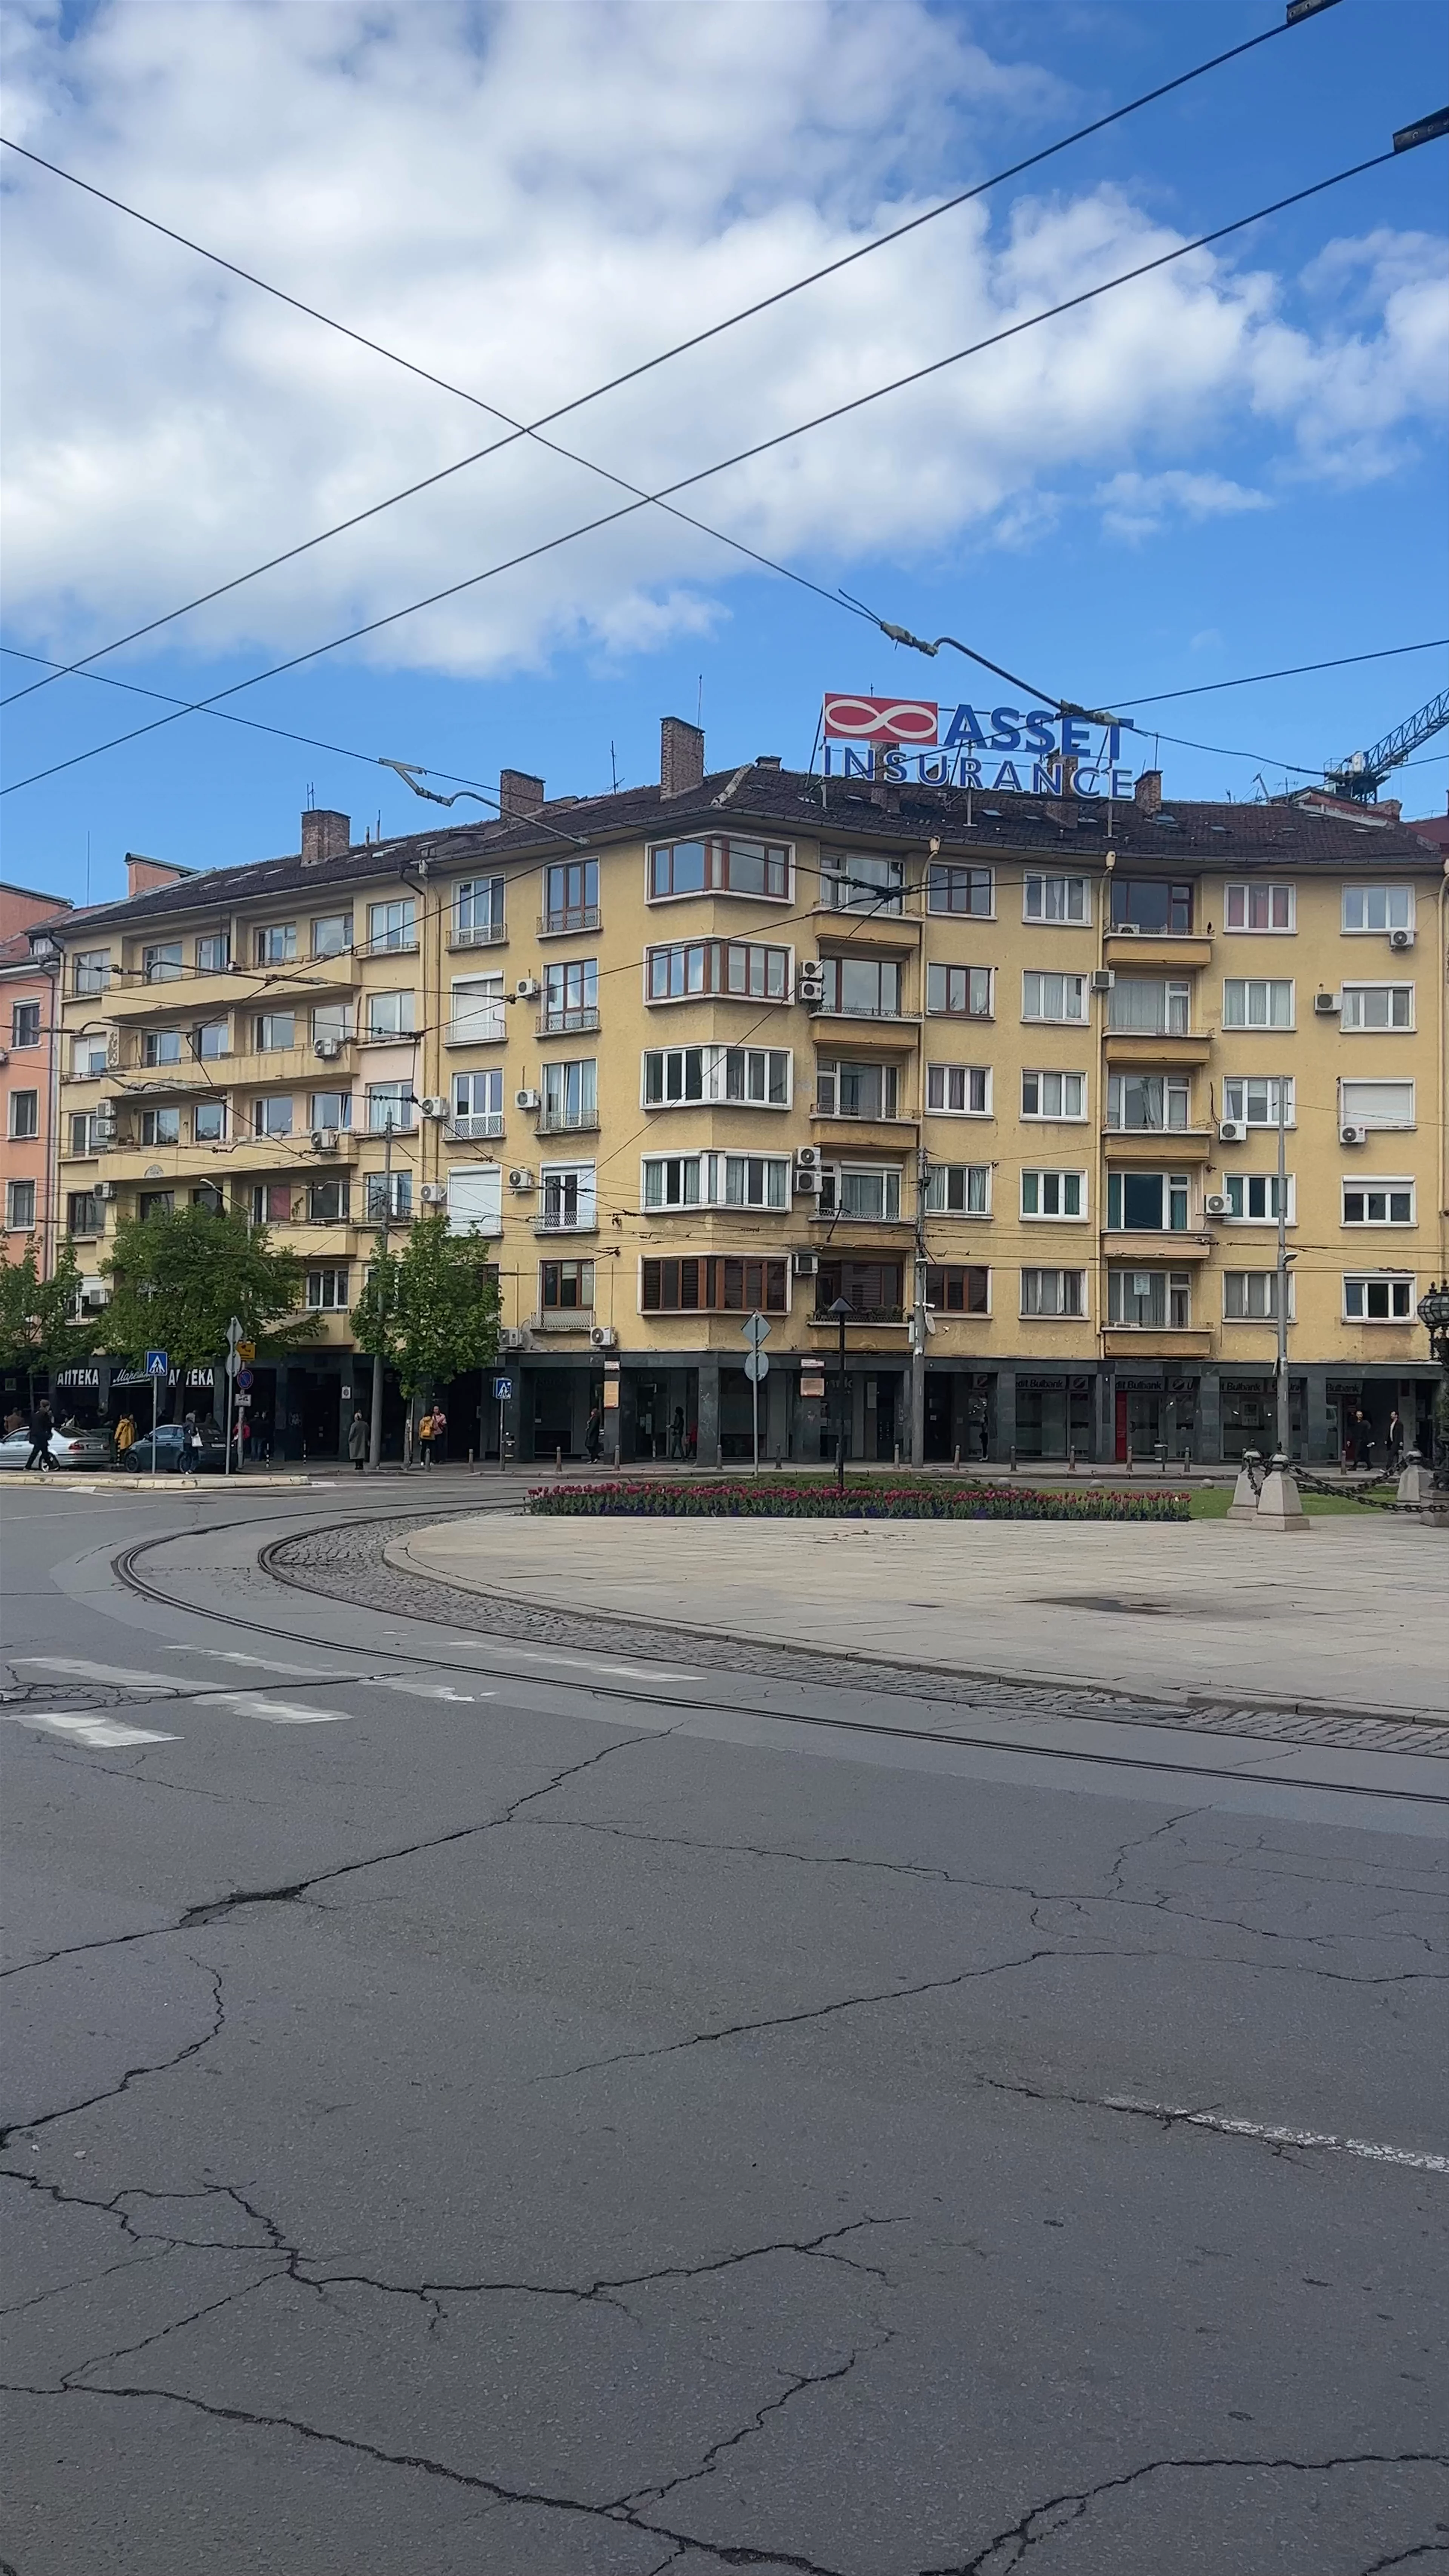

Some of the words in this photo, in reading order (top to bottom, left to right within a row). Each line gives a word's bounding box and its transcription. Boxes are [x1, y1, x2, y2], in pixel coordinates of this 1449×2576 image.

[944, 704, 1134, 760] ASSET
[823, 744, 1135, 801] INSURANCE
[57, 1369, 99, 1385] АПТЕКА
